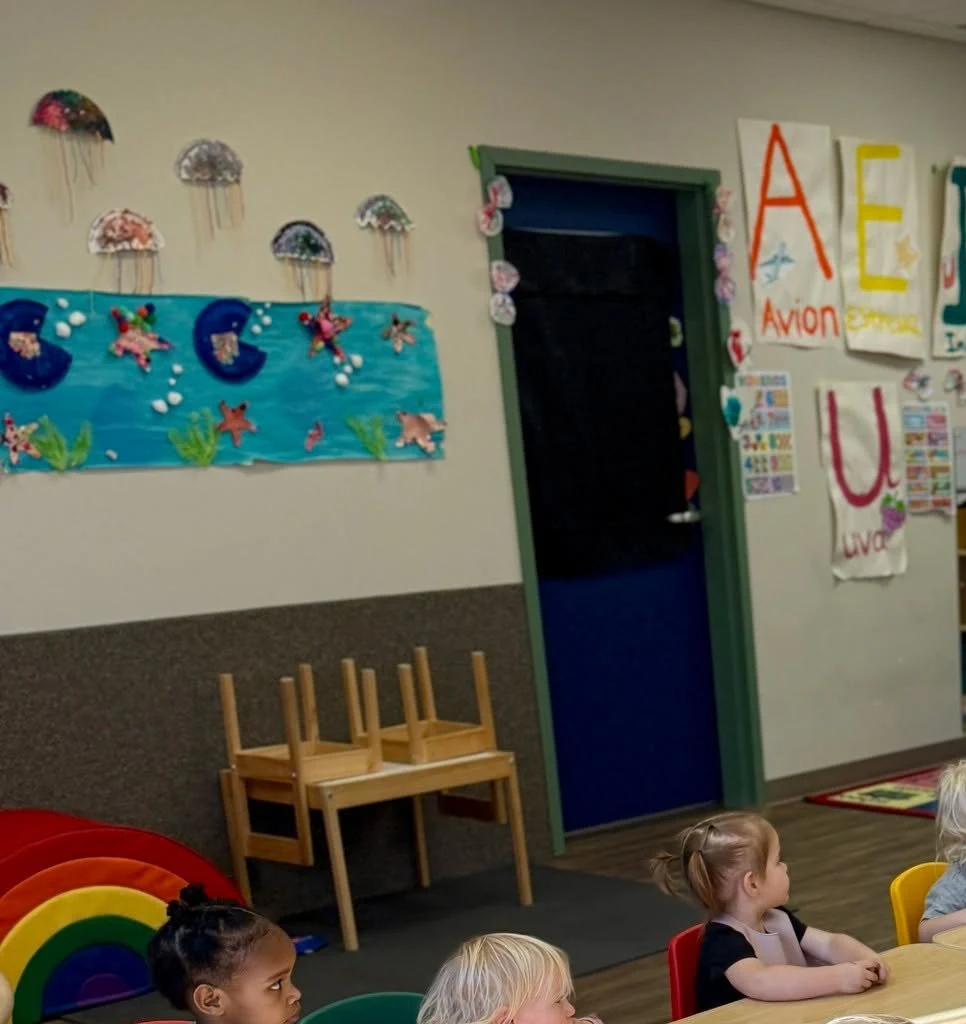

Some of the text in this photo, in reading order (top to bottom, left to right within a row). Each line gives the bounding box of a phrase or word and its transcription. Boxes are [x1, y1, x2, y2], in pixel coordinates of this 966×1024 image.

[751, 122, 833, 281] A
[857, 144, 908, 292] E
[827, 385, 899, 508] U
